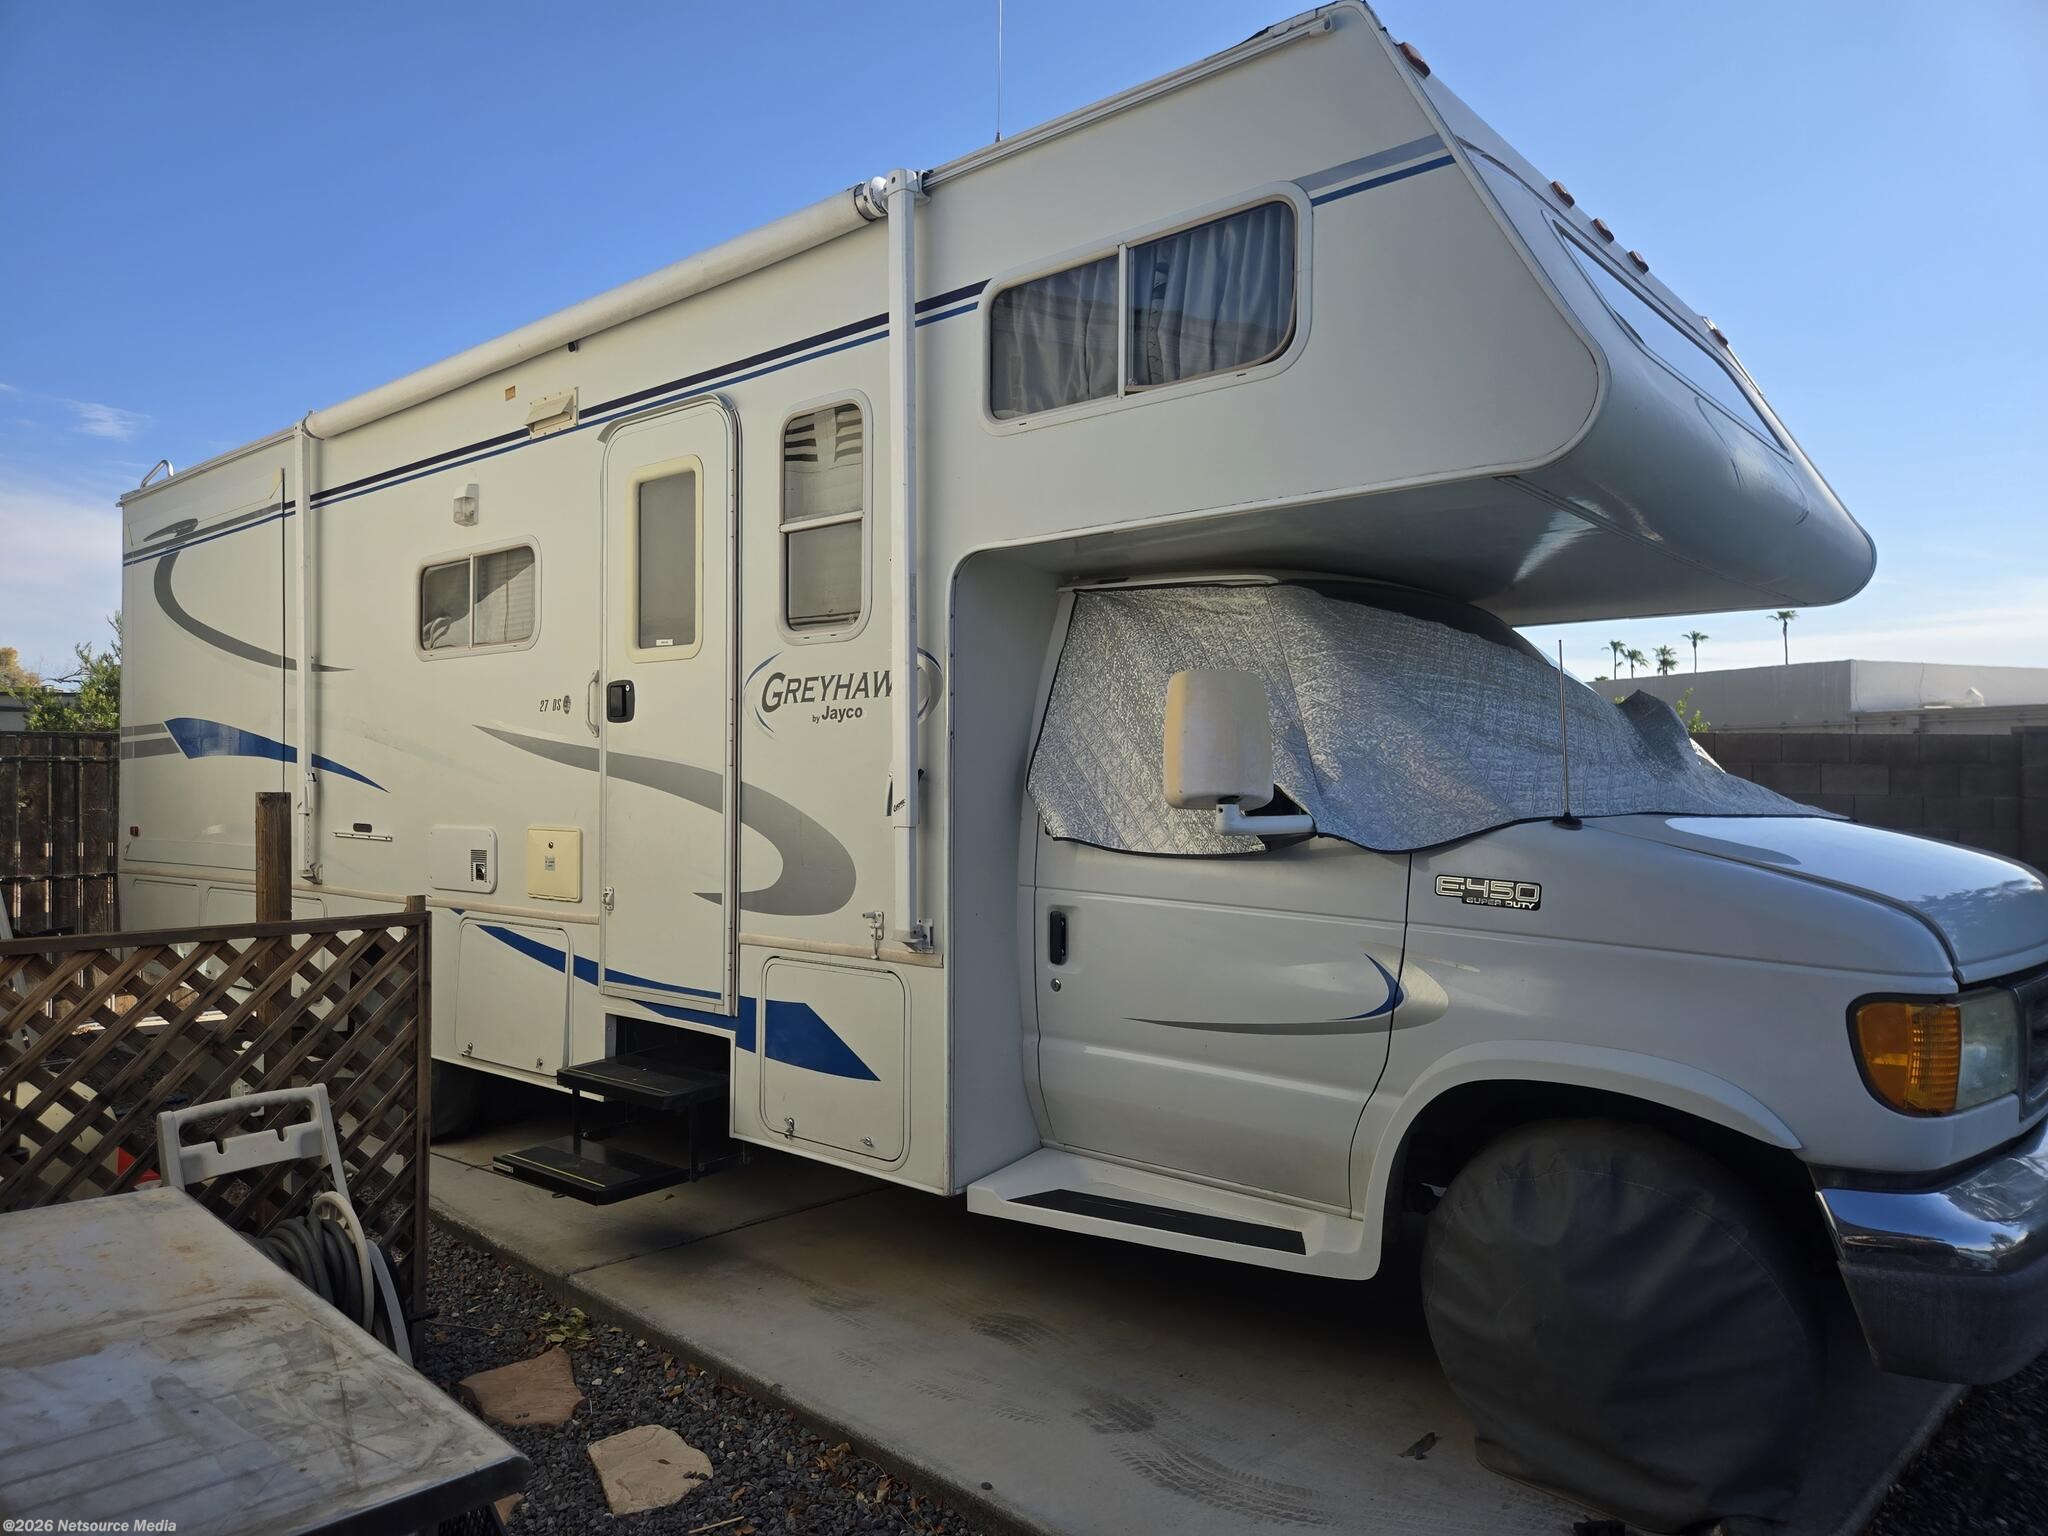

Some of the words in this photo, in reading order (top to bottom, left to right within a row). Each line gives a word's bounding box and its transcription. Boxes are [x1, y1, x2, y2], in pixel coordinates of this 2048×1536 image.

[762, 670, 892, 713] GREYHAW
[539, 700, 549, 712] 27
[812, 714, 820, 724] by
[821, 705, 863, 722] Jayco
[1466, 897, 1502, 906] SUPER
[1505, 901, 1535, 909] DUTY
